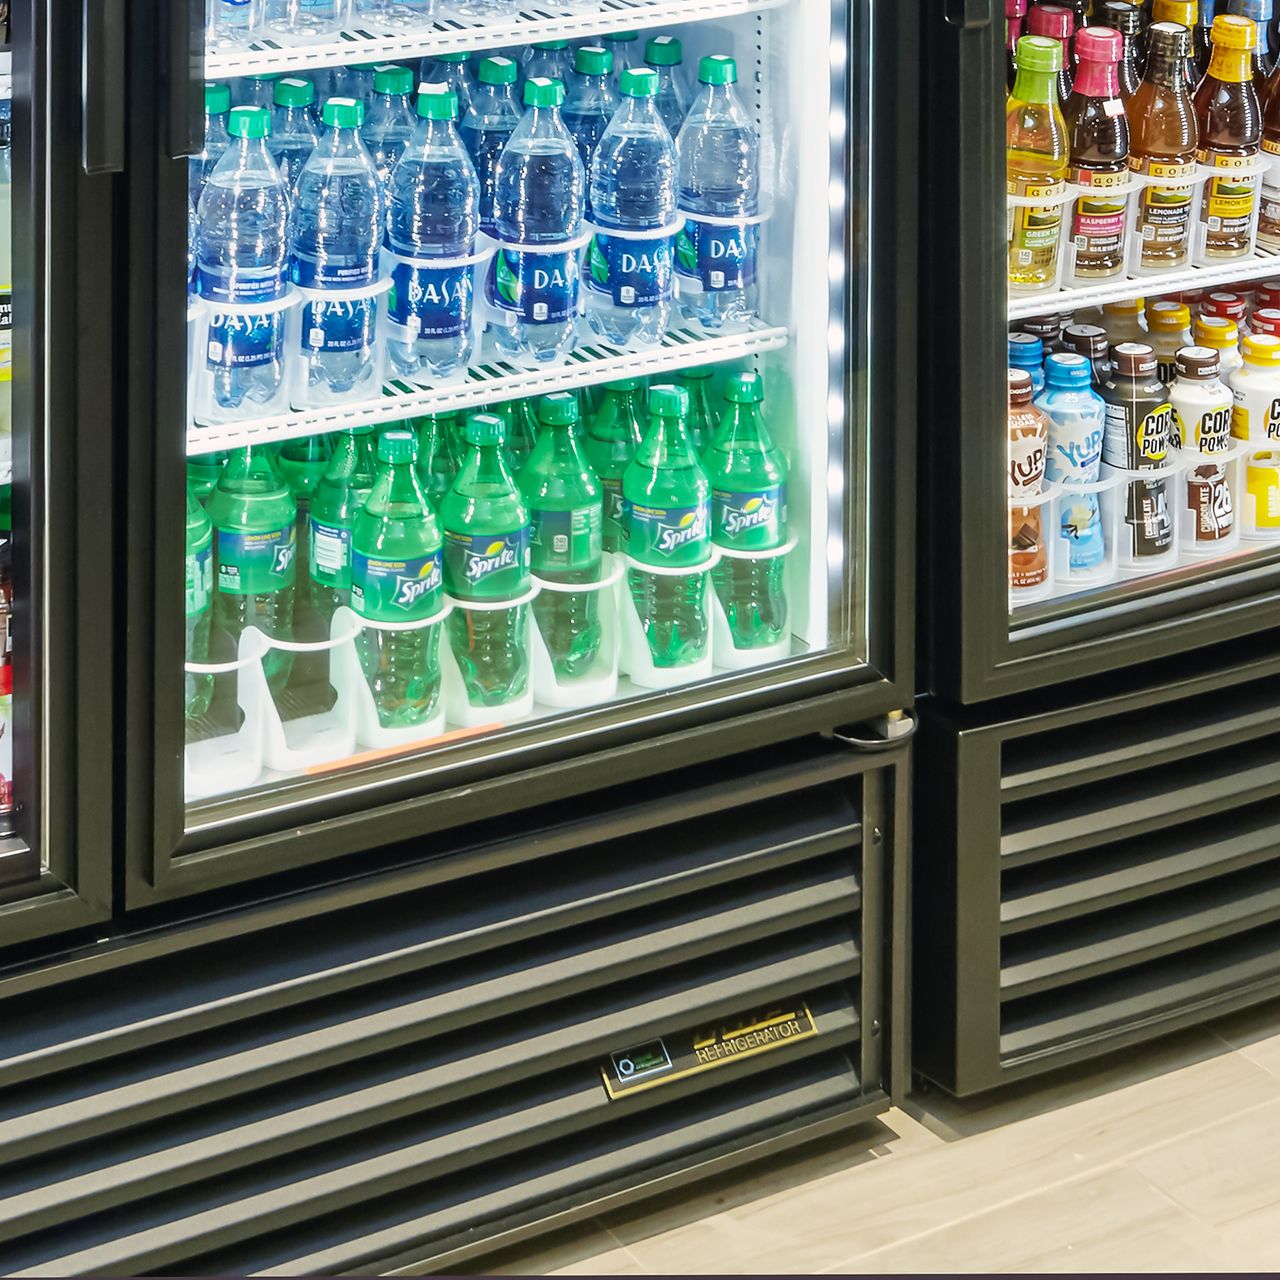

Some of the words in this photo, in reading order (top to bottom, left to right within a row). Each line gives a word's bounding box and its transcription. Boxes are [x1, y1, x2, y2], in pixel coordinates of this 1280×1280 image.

[1080, 216, 1118, 225] RASPBERRY
[1149, 207, 1183, 216] LEMONADE
[1064, 392, 1079, 404] 25
[724, 507, 771, 533] Sprite
[469, 547, 514, 578] Sprite
[696, 1020, 802, 1064] REFRIGERATOR
